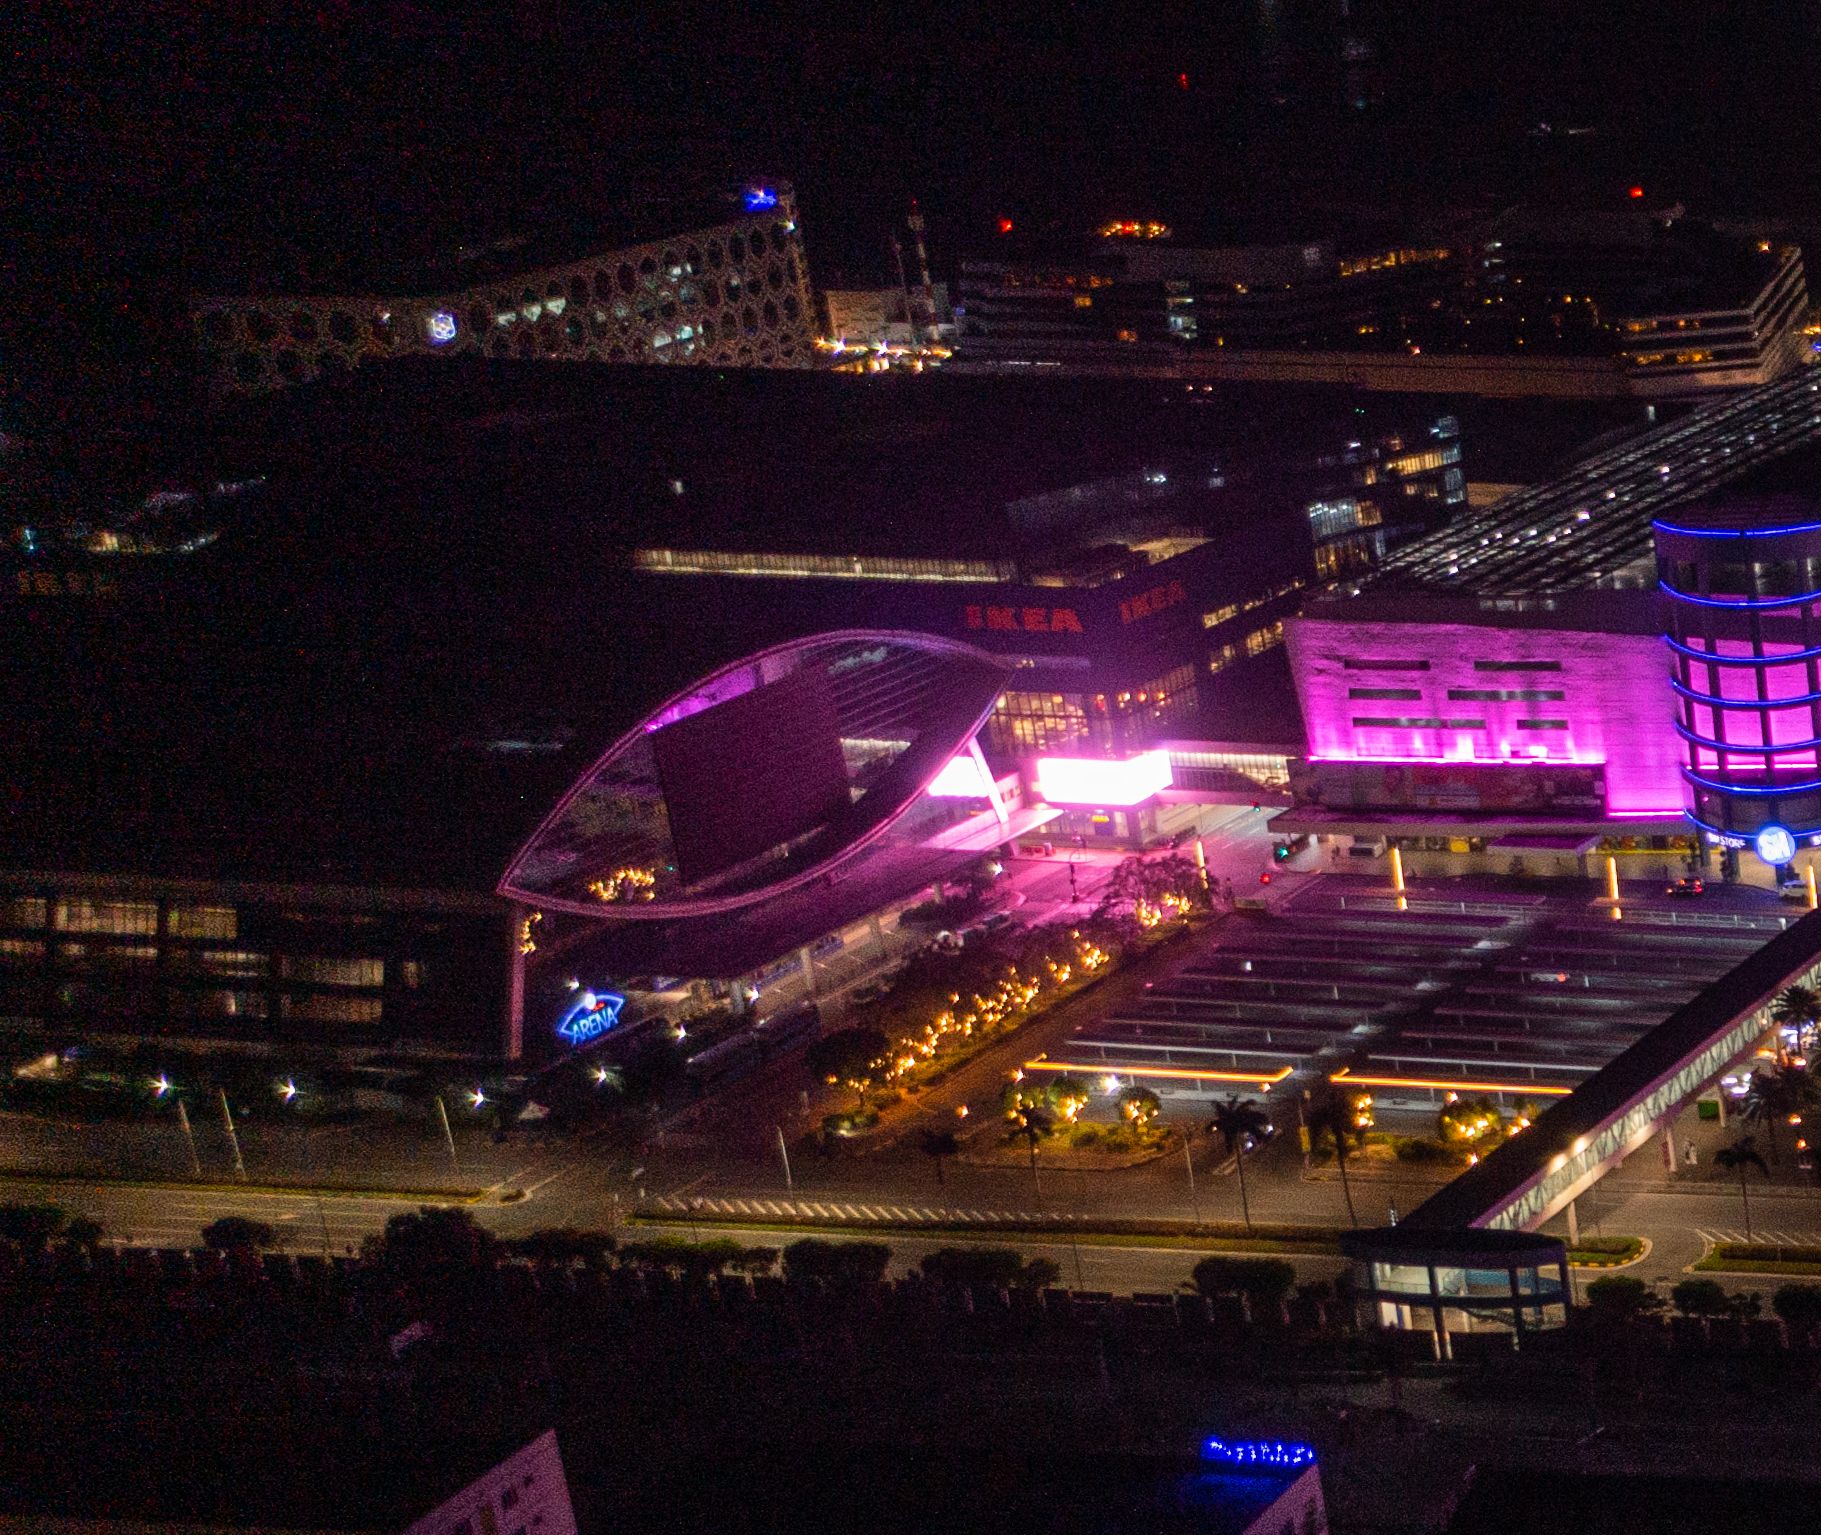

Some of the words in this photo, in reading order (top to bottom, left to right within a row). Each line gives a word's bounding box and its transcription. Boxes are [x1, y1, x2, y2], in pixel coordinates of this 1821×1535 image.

[966, 604, 1085, 633] IKEA
[1719, 836, 1747, 849] STORE
[571, 1006, 619, 1045] ARENA
